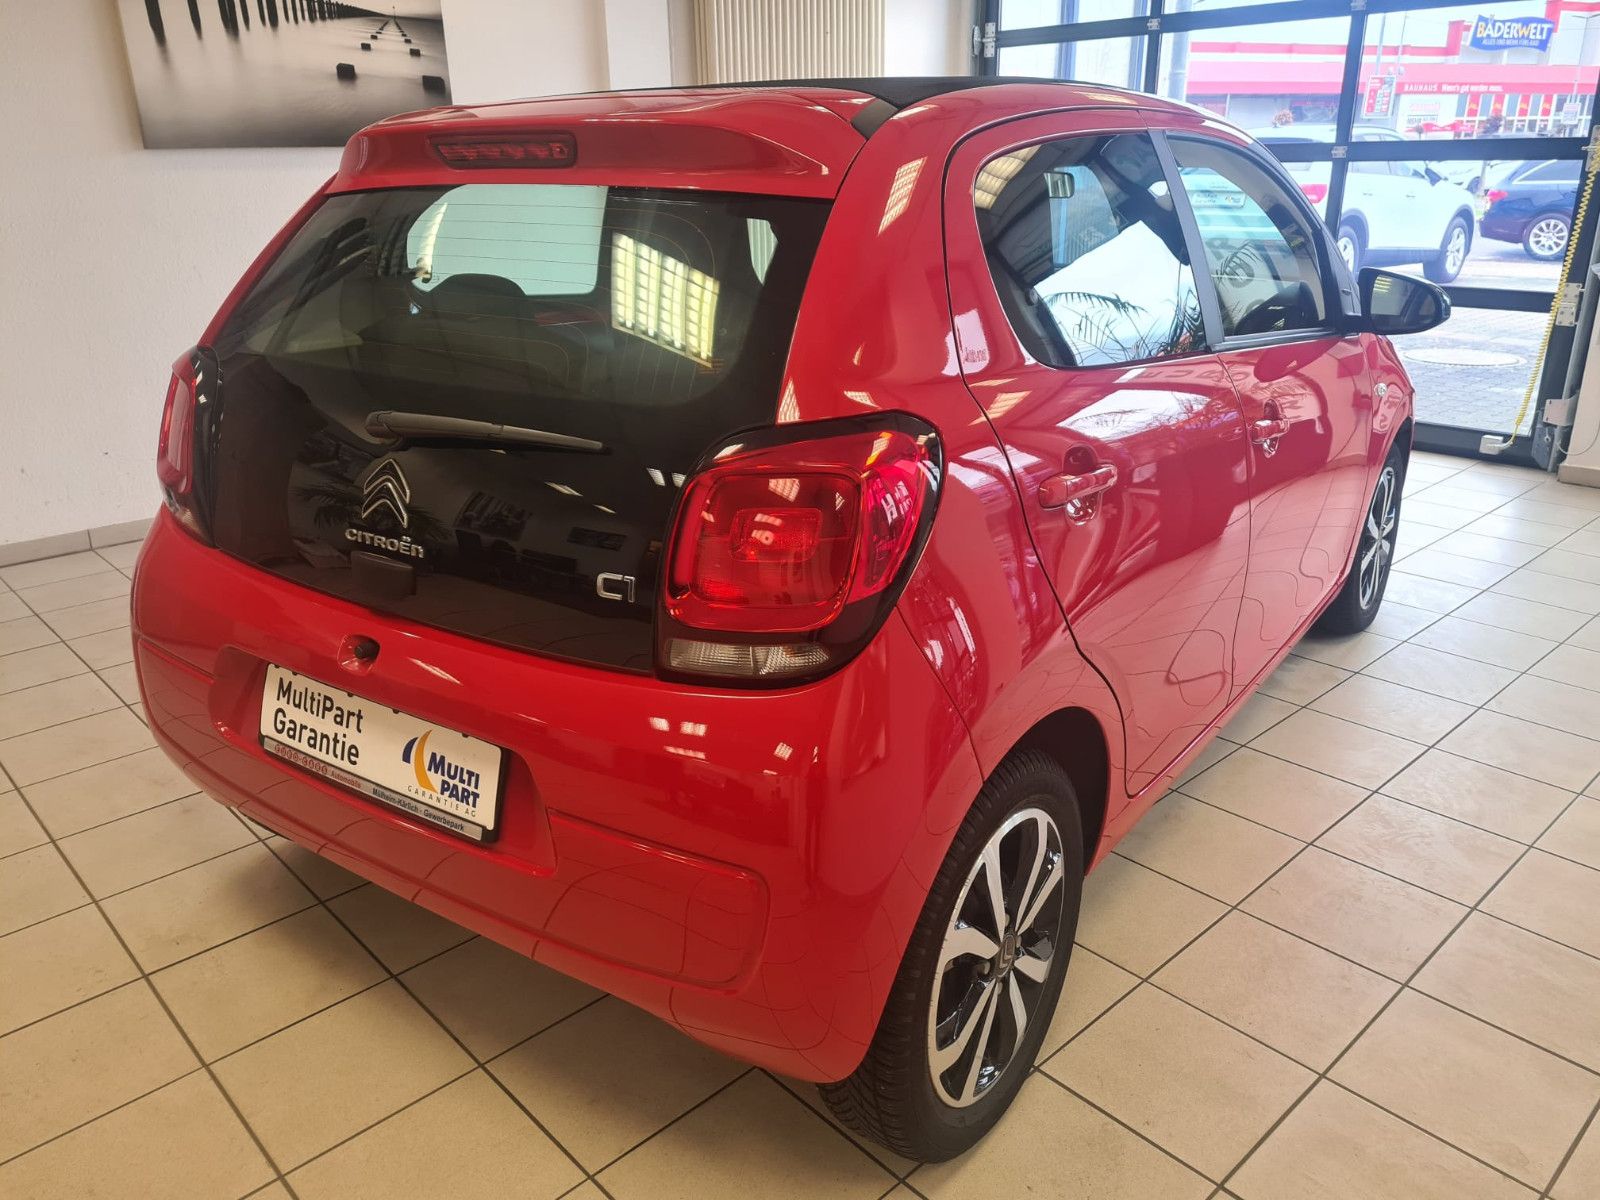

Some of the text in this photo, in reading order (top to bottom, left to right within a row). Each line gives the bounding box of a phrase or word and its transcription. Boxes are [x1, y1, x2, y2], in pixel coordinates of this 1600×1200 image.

[1476, 19, 1554, 40] BÄDERWELT
[596, 571, 636, 603] C1
[276, 677, 363, 733] MultiPart
[273, 708, 360, 766] Garantie
[427, 752, 480, 790] MULTI
[407, 785, 476, 818] GARANTIE AG
[440, 780, 480, 809] PART
